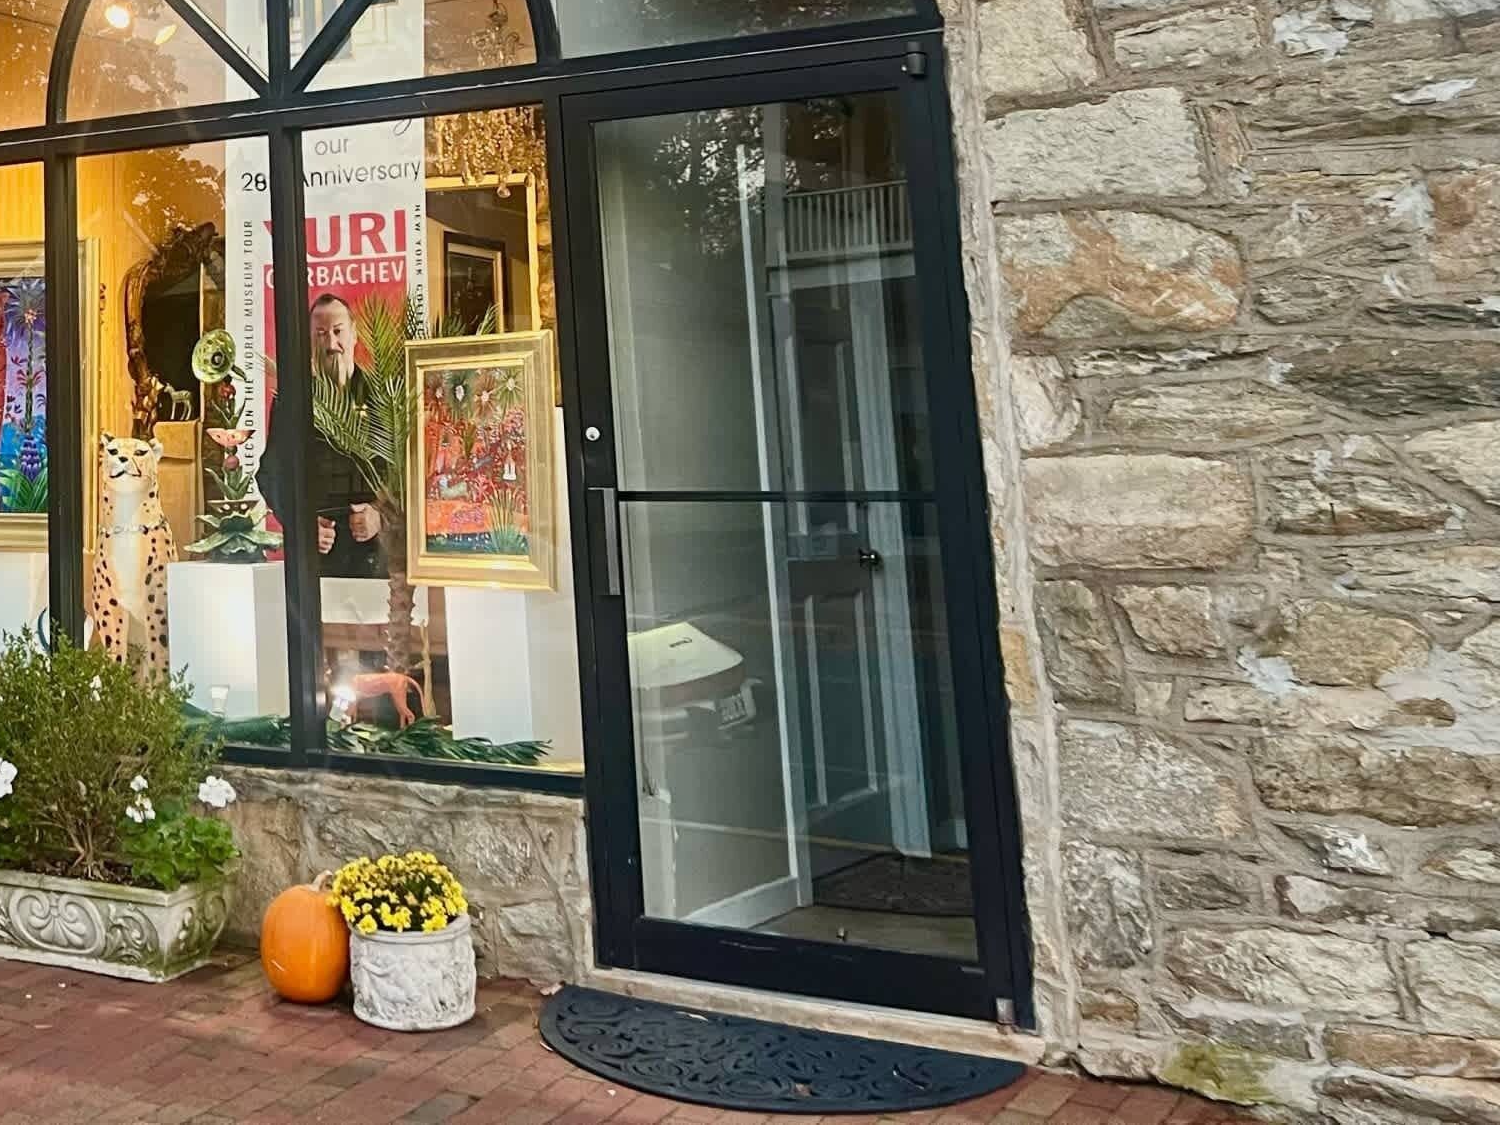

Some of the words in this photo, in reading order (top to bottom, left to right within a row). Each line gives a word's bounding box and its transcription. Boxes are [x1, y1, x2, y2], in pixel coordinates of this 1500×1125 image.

[314, 138, 349, 156] our
[241, 172, 267, 192] 28
[243, 220, 253, 254] TOUR
[263, 209, 406, 259] URI
[243, 261, 254, 317] MUSEUM
[244, 324, 255, 370] WORLD
